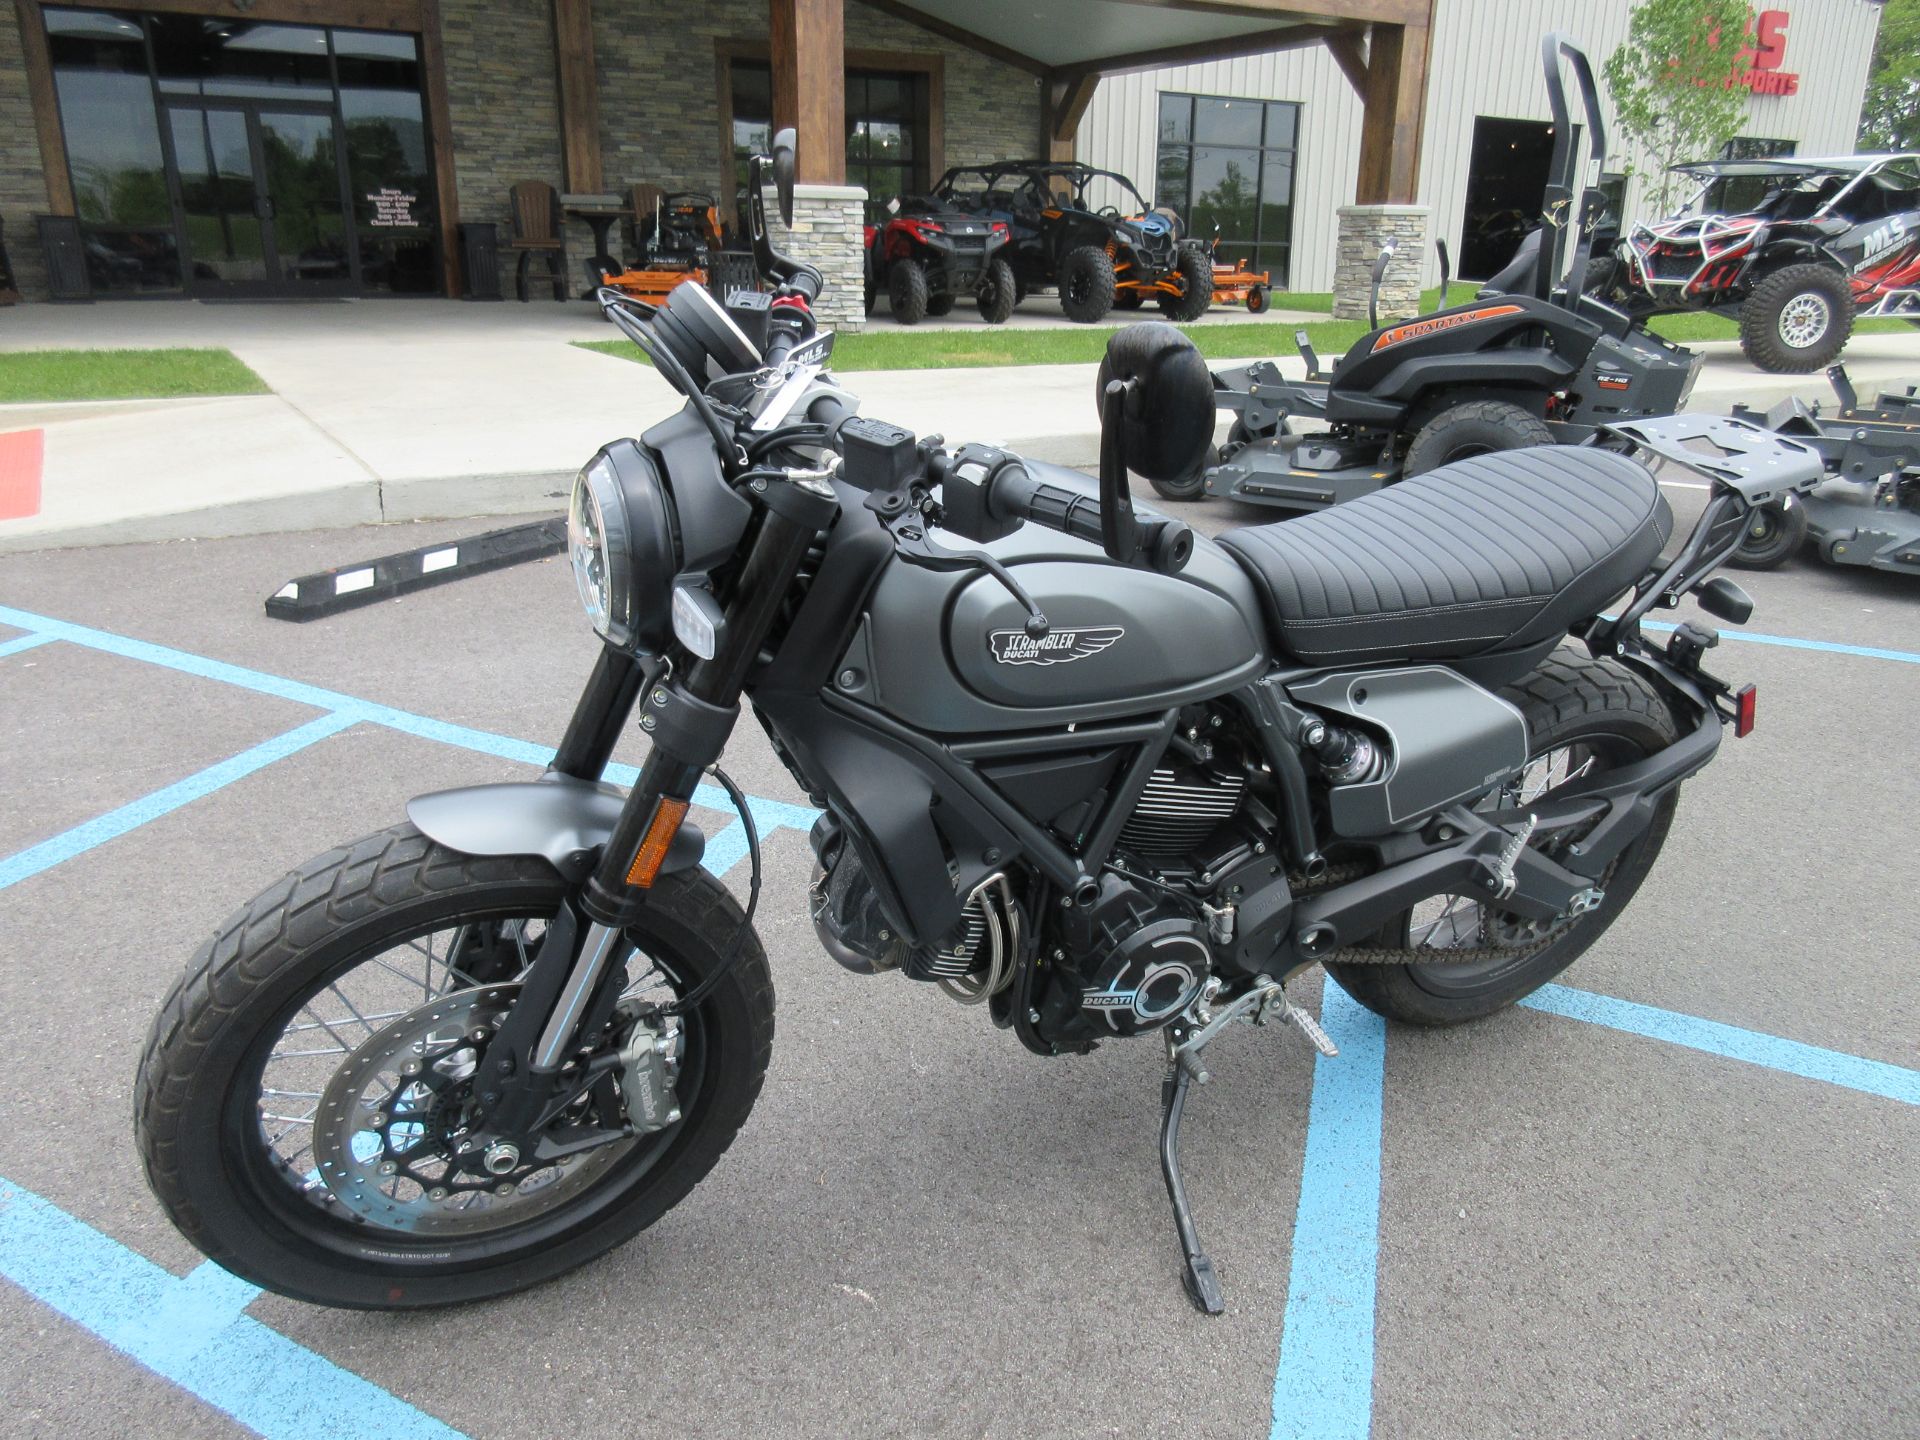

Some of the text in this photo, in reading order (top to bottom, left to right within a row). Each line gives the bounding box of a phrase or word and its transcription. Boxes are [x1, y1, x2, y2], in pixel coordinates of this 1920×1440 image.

[1863, 215, 1905, 259] MLS
[1853, 233, 1915, 275] POWERSPORTS
[799, 344, 824, 365] MLS
[1005, 633, 1076, 651] SCRAMBLER
[1003, 650, 1039, 659] DUCATI
[1082, 996, 1132, 1005] DUCATI
